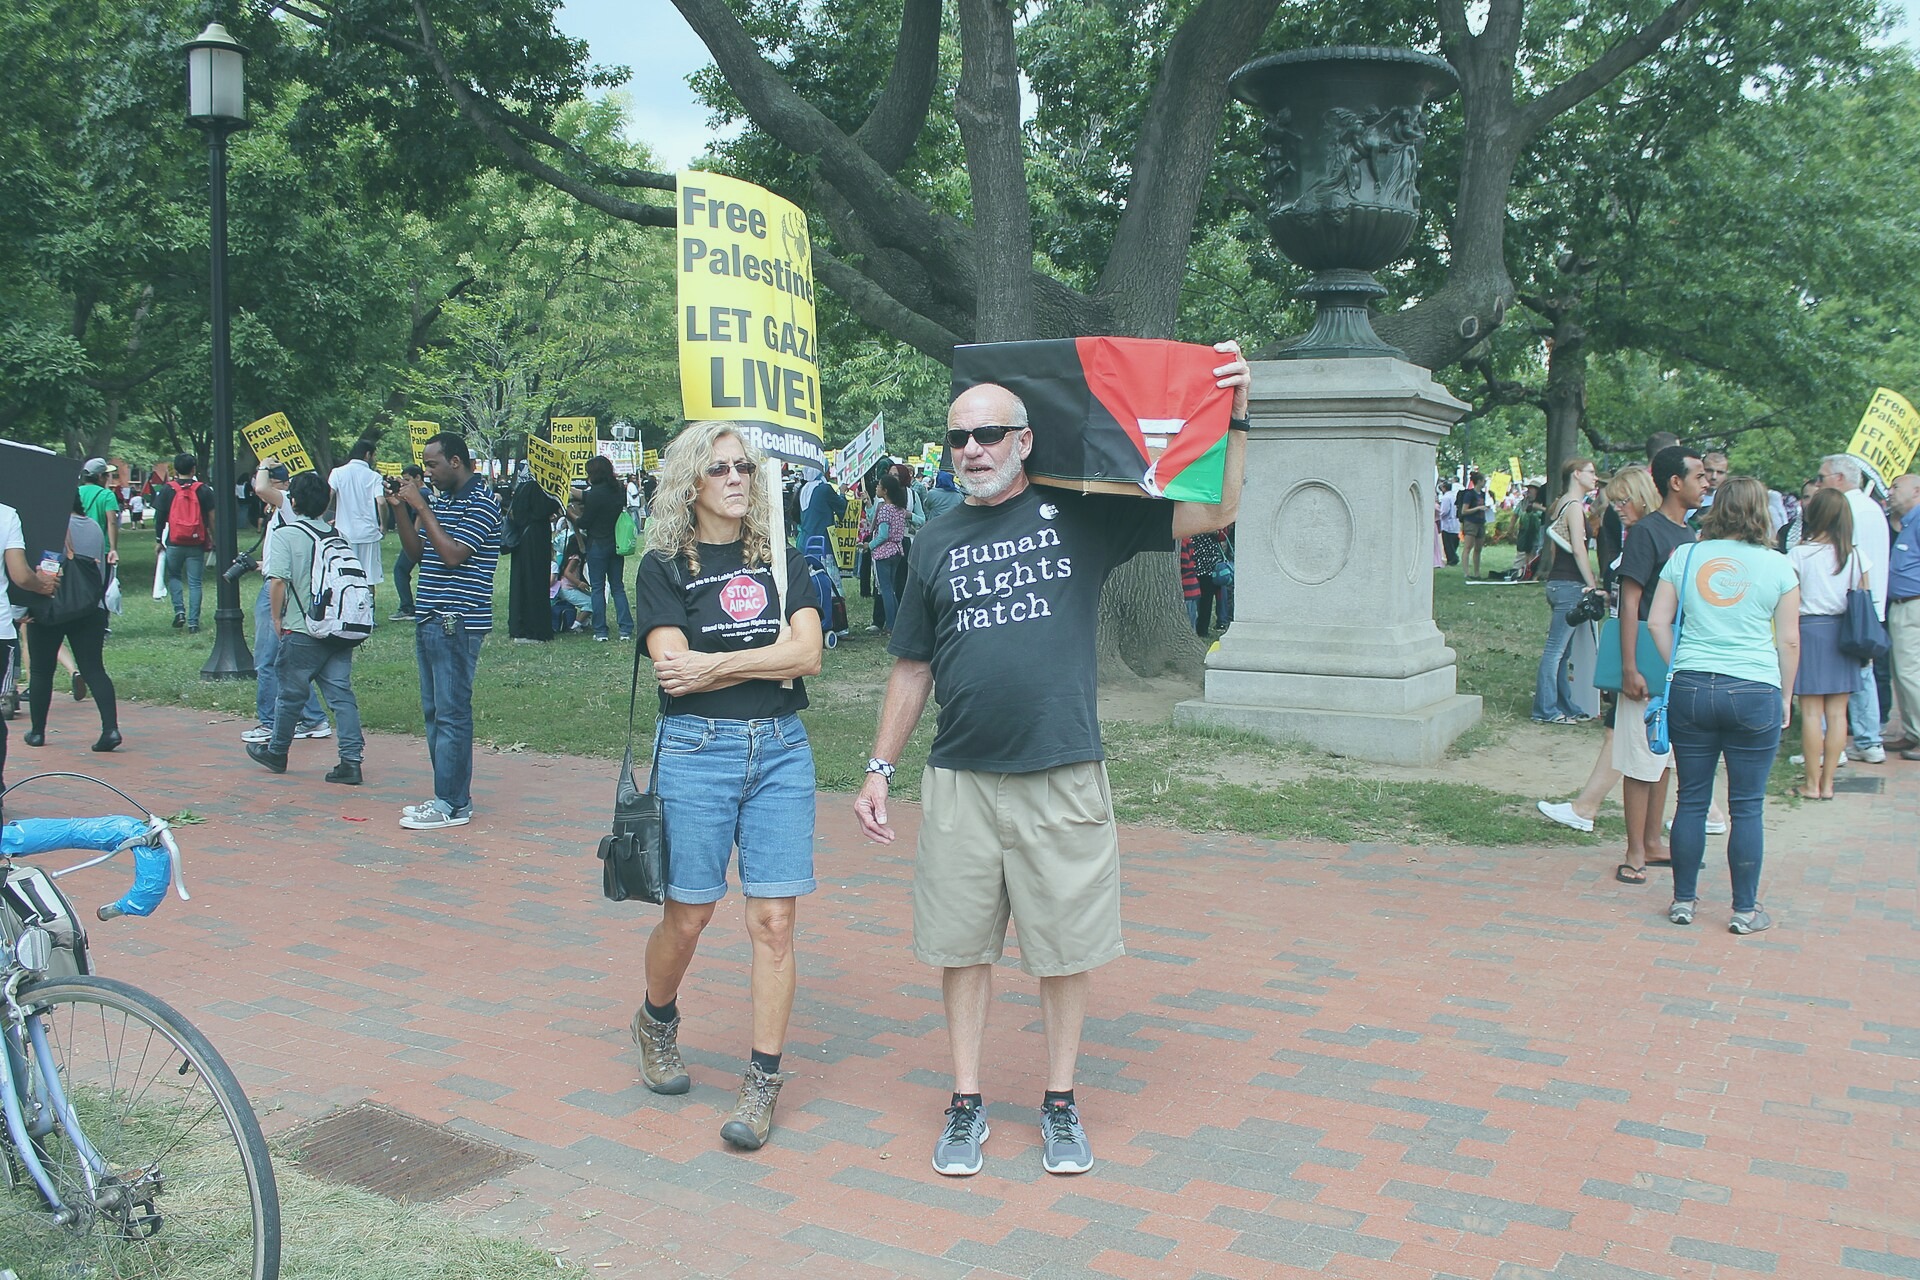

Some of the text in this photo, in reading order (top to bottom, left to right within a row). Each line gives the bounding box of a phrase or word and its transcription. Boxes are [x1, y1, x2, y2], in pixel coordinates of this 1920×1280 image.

[683, 187, 767, 239] Free
[683, 237, 814, 307] Palestine
[686, 305, 752, 343] LET
[710, 357, 816, 424] LIVE!
[1874, 393, 1906, 418] Free
[246, 424, 272, 442] Free
[410, 424, 428, 435] Free
[552, 421, 573, 432] Free
[1868, 406, 1916, 452] Palestine
[247, 430, 294, 452] Palestine
[529, 437, 554, 458] Free
[552, 434, 594, 444] Palestine
[1860, 423, 1906, 471] LET GAZA
[281, 443, 304, 458] GAZA
[415, 451, 424, 459] LE
[569, 450, 594, 460] GAZA
[284, 456, 308, 472] VE!
[528, 460, 545, 475] LET
[1860, 441, 1895, 482] LIVE!
[949, 527, 1061, 572] Human
[718, 572, 734, 581] Lobby
[949, 557, 1072, 603] Rights
[726, 585, 757, 599] STOP
[729, 598, 761, 613] AIPAC
[956, 592, 1052, 632] Watch
[701, 624, 717, 633] Stand
